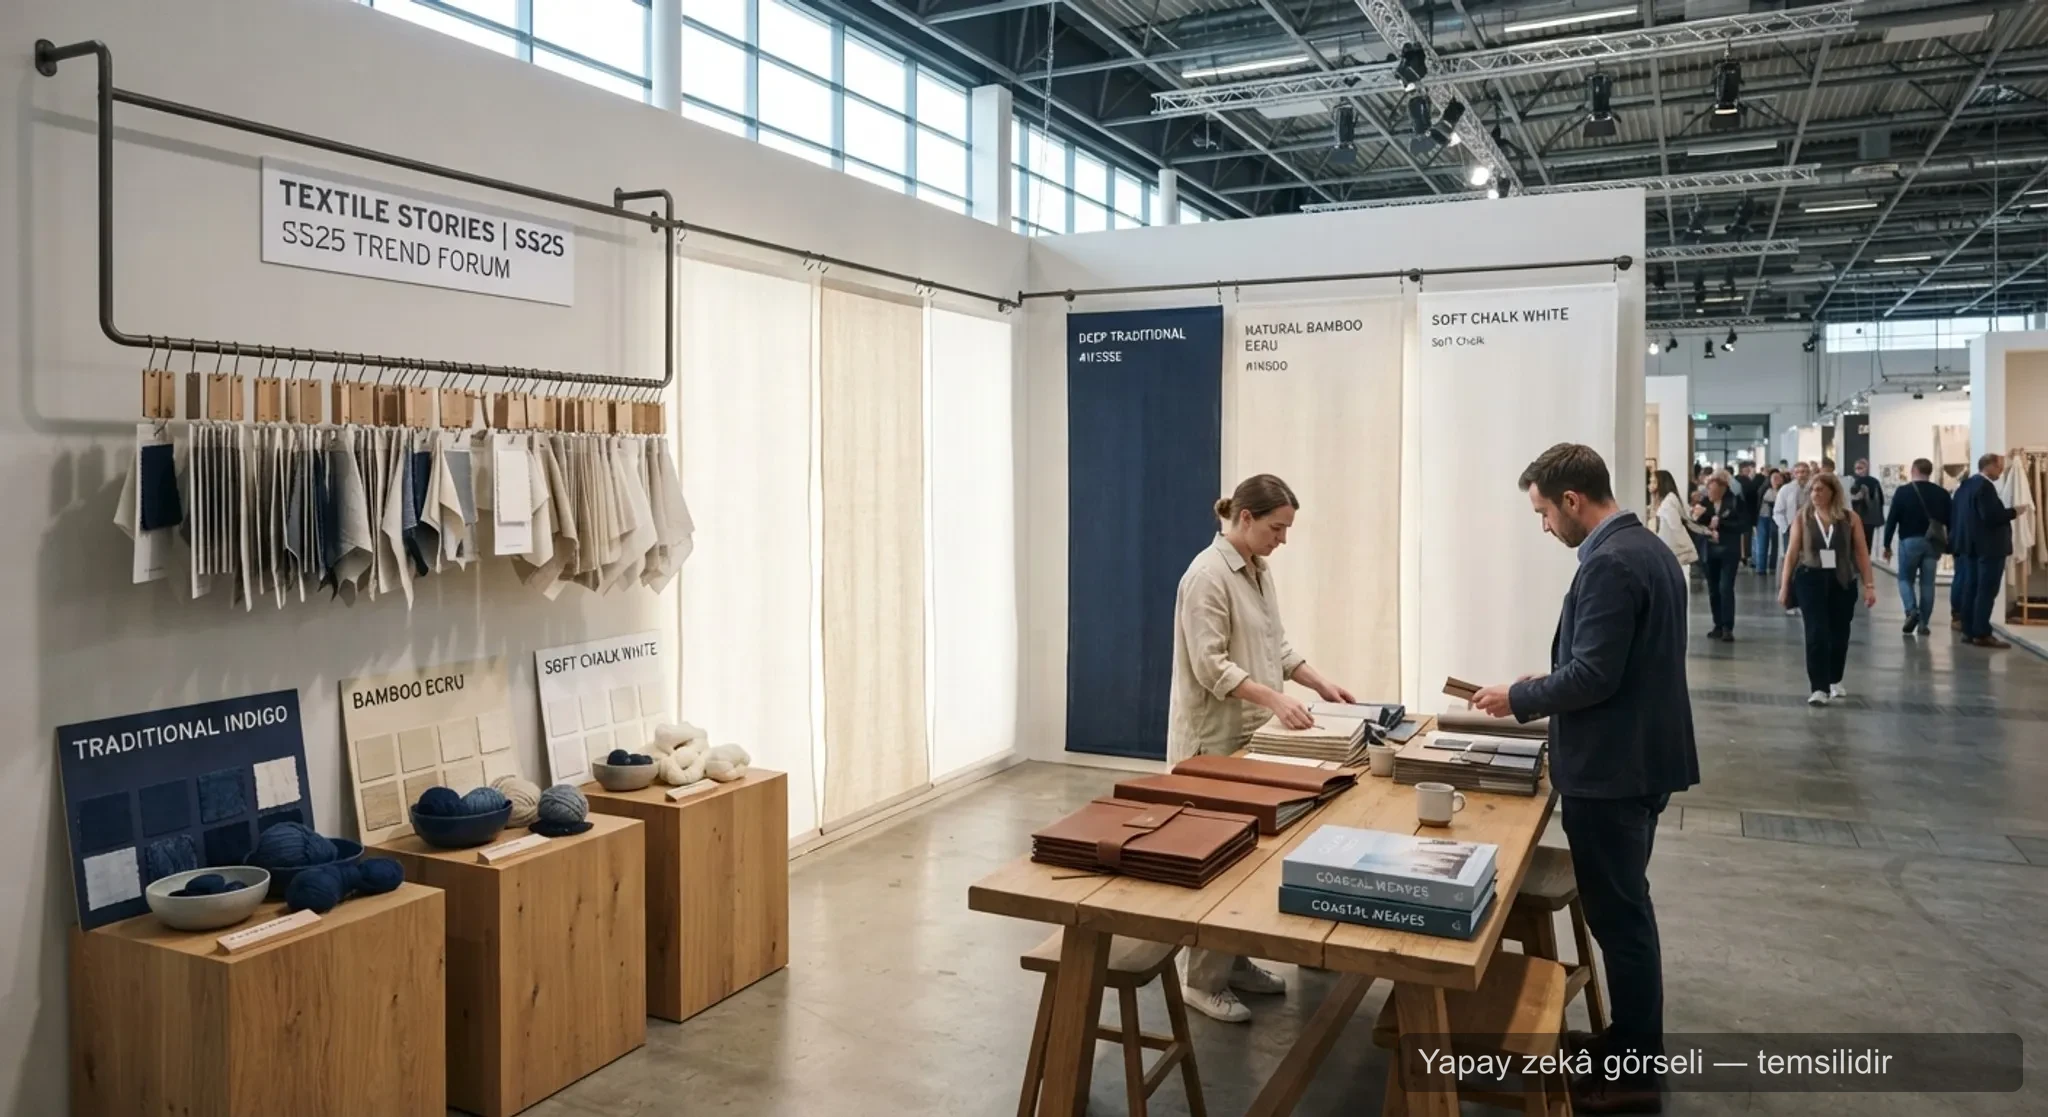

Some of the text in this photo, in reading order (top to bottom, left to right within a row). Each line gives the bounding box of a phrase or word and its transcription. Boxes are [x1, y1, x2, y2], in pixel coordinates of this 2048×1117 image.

[279, 178, 390, 224] TEXTILE
[397, 203, 495, 243] STORIES
[282, 220, 511, 279] SS25 TREND FORUM
[1306, 318, 1363, 334] BAMBOO
[1431, 307, 1570, 326] SOFT CHALK WHITE
[352, 673, 464, 709] BAMBOO ECRU
[72, 705, 288, 760] TRADITIONAL INDIGO
